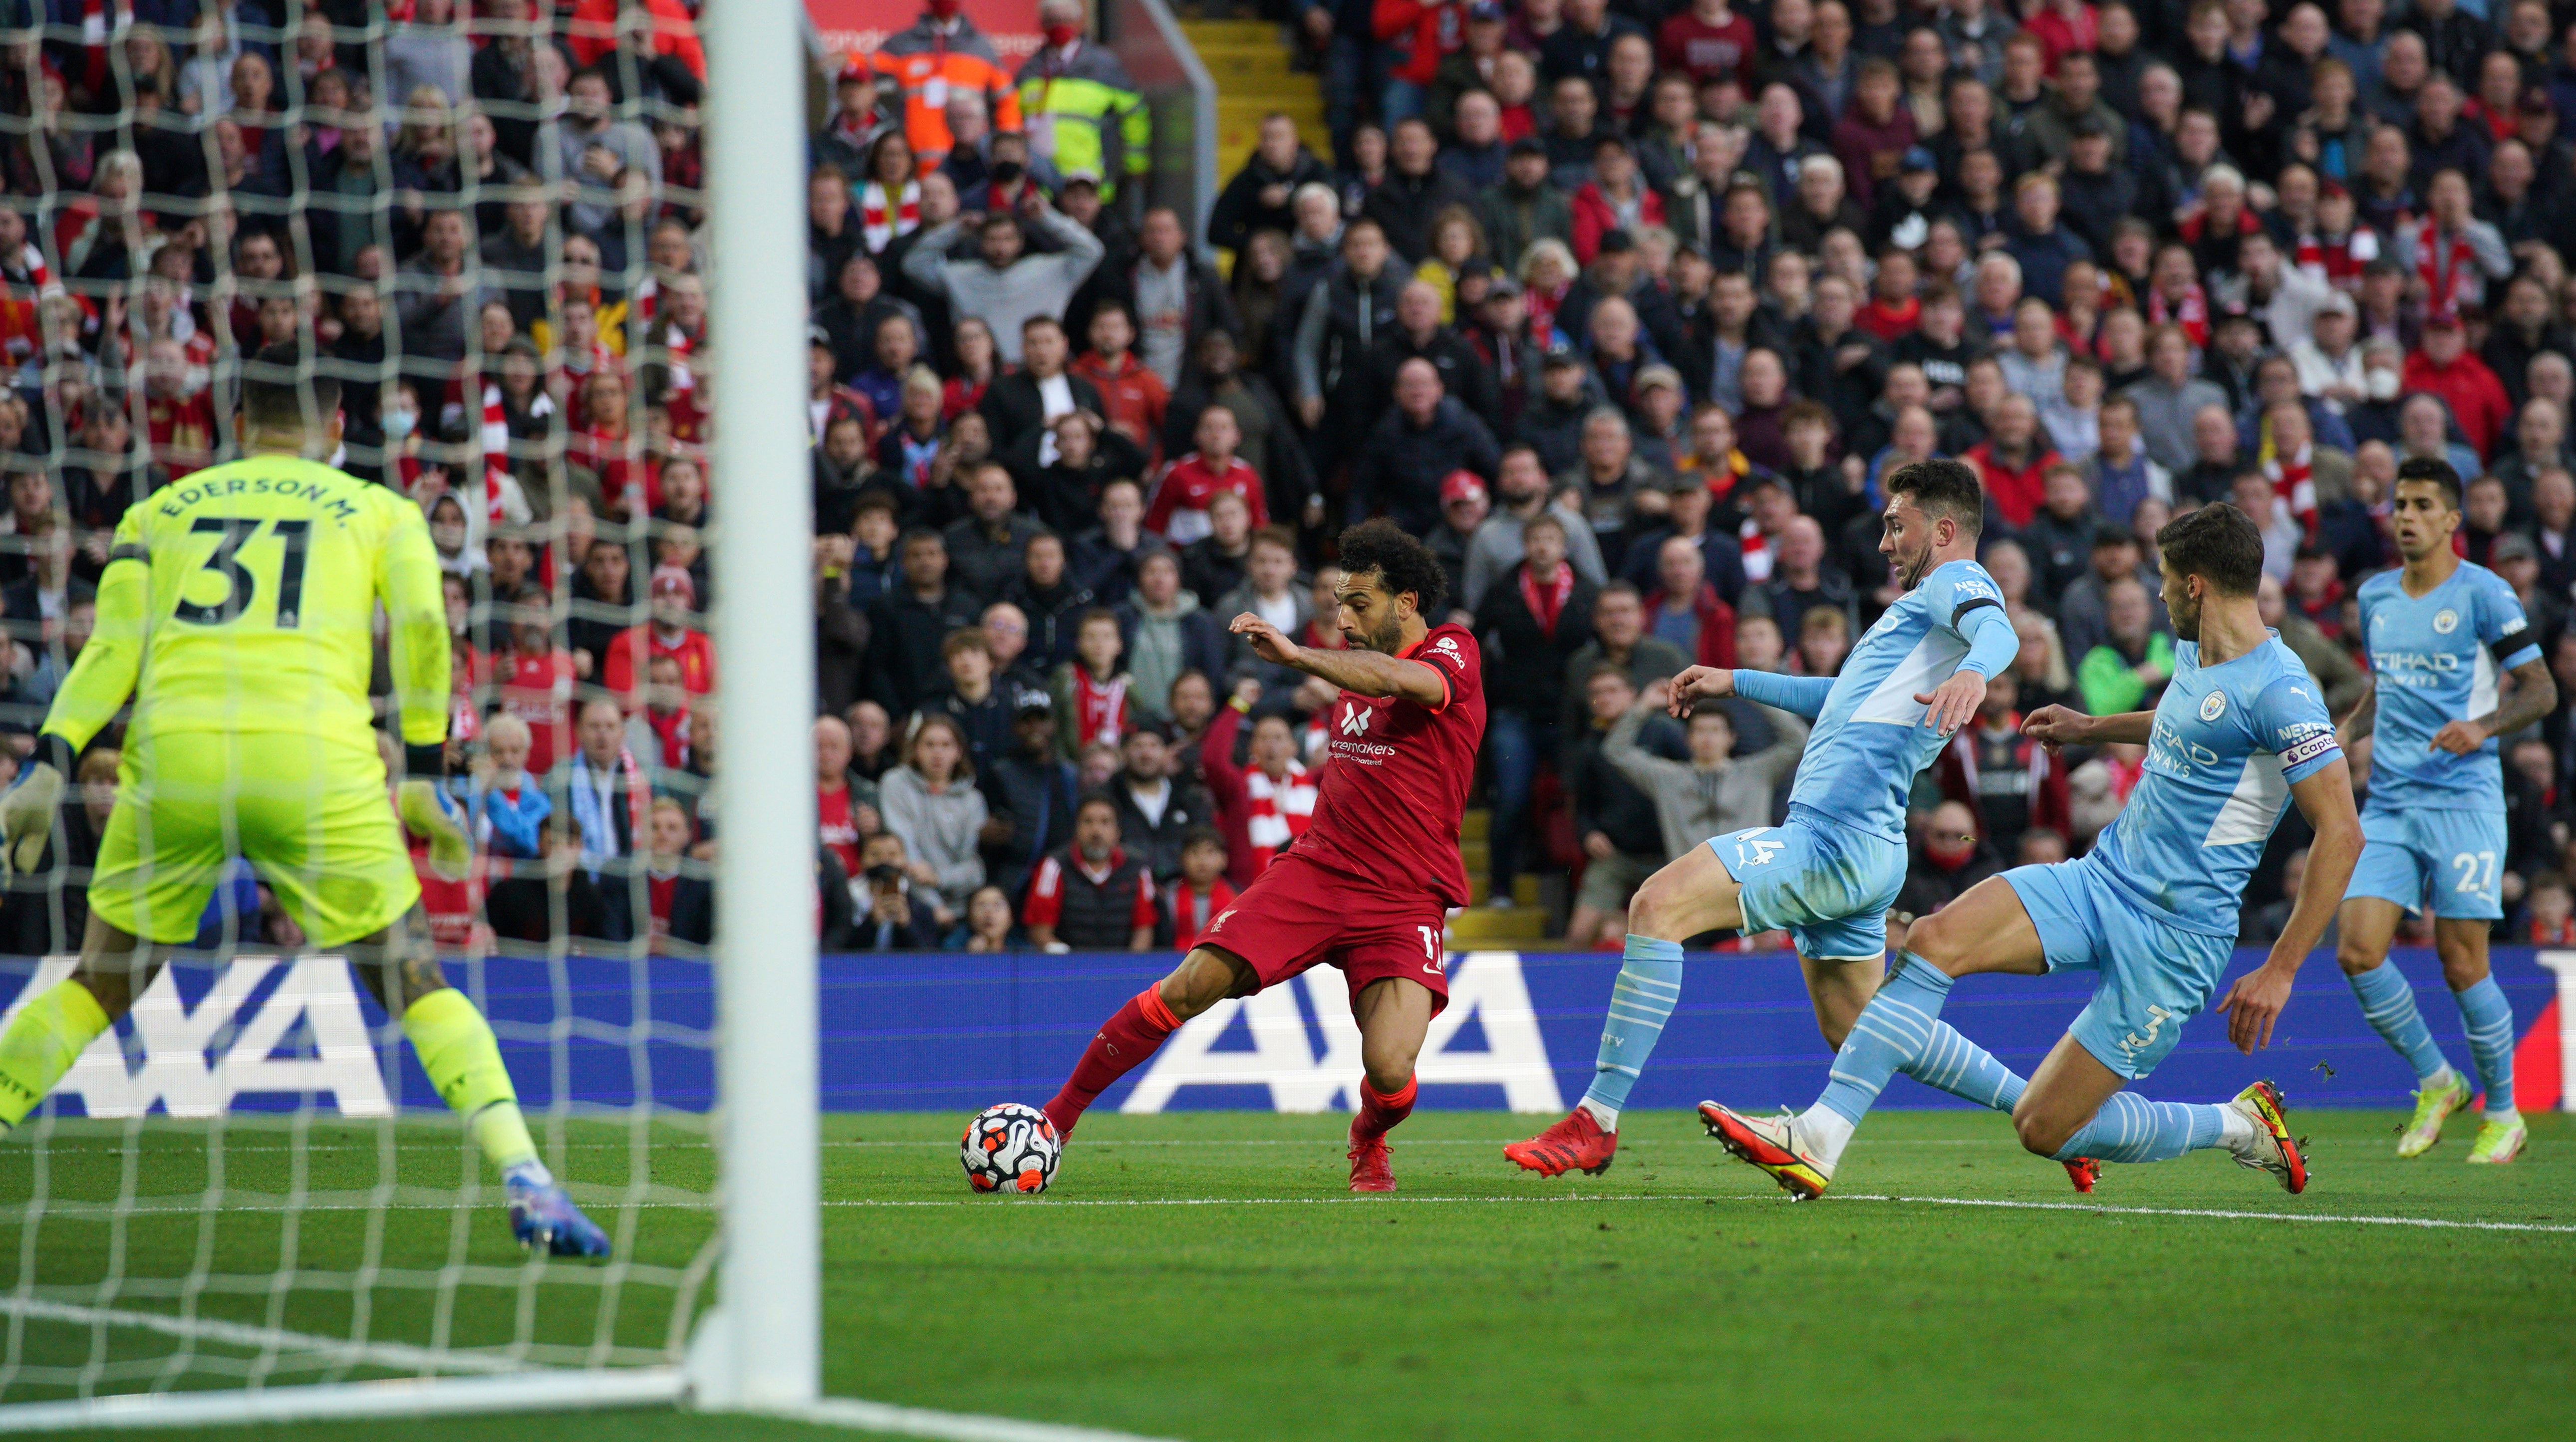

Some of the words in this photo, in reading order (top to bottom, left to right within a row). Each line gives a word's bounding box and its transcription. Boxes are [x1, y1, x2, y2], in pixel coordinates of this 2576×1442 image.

[160, 477, 328, 518] EDERSON
[323, 498, 359, 528] M.
[173, 517, 313, 629] 31
[2371, 652, 2458, 671] TIHAD
[2153, 717, 2219, 765] IHAD
[2300, 737, 2335, 756] Capta
[1734, 826, 1786, 866] 14
[2452, 851, 2495, 892] 27
[1417, 925, 1442, 971] 11
[1119, 950, 1564, 1114] AXA
[2126, 1003, 2172, 1047] 3
